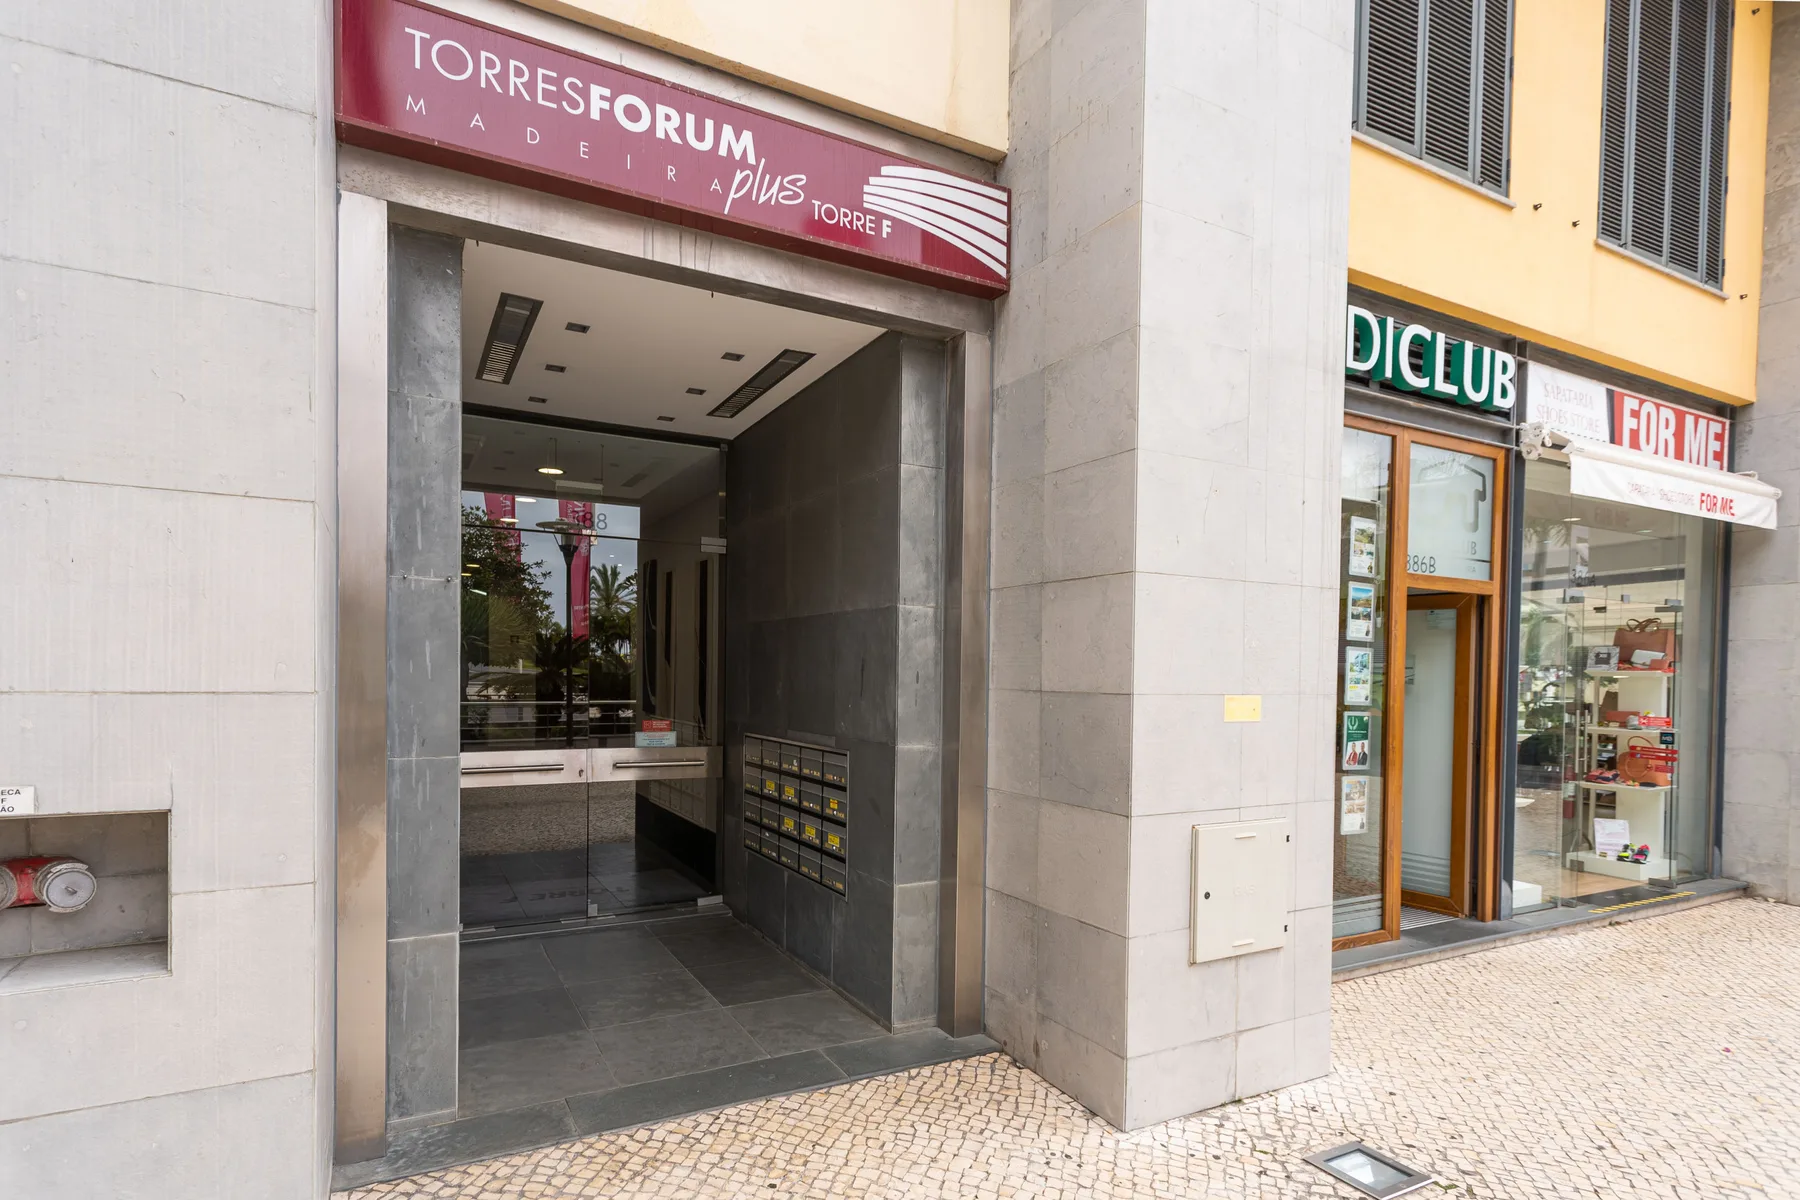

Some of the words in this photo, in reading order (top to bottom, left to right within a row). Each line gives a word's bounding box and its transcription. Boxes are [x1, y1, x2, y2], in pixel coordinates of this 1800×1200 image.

[406, 94, 723, 194] MADEIRA
[723, 157, 807, 215] plus
[812, 199, 876, 235] TORRE
[882, 219, 892, 238] F
[1536, 403, 1568, 426] SHOES
[1570, 411, 1600, 434] STORE
[1622, 395, 1676, 461] FOR
[1683, 413, 1723, 471] ME
[1699, 492, 1718, 514] FOR
[1720, 496, 1735, 517] ME
